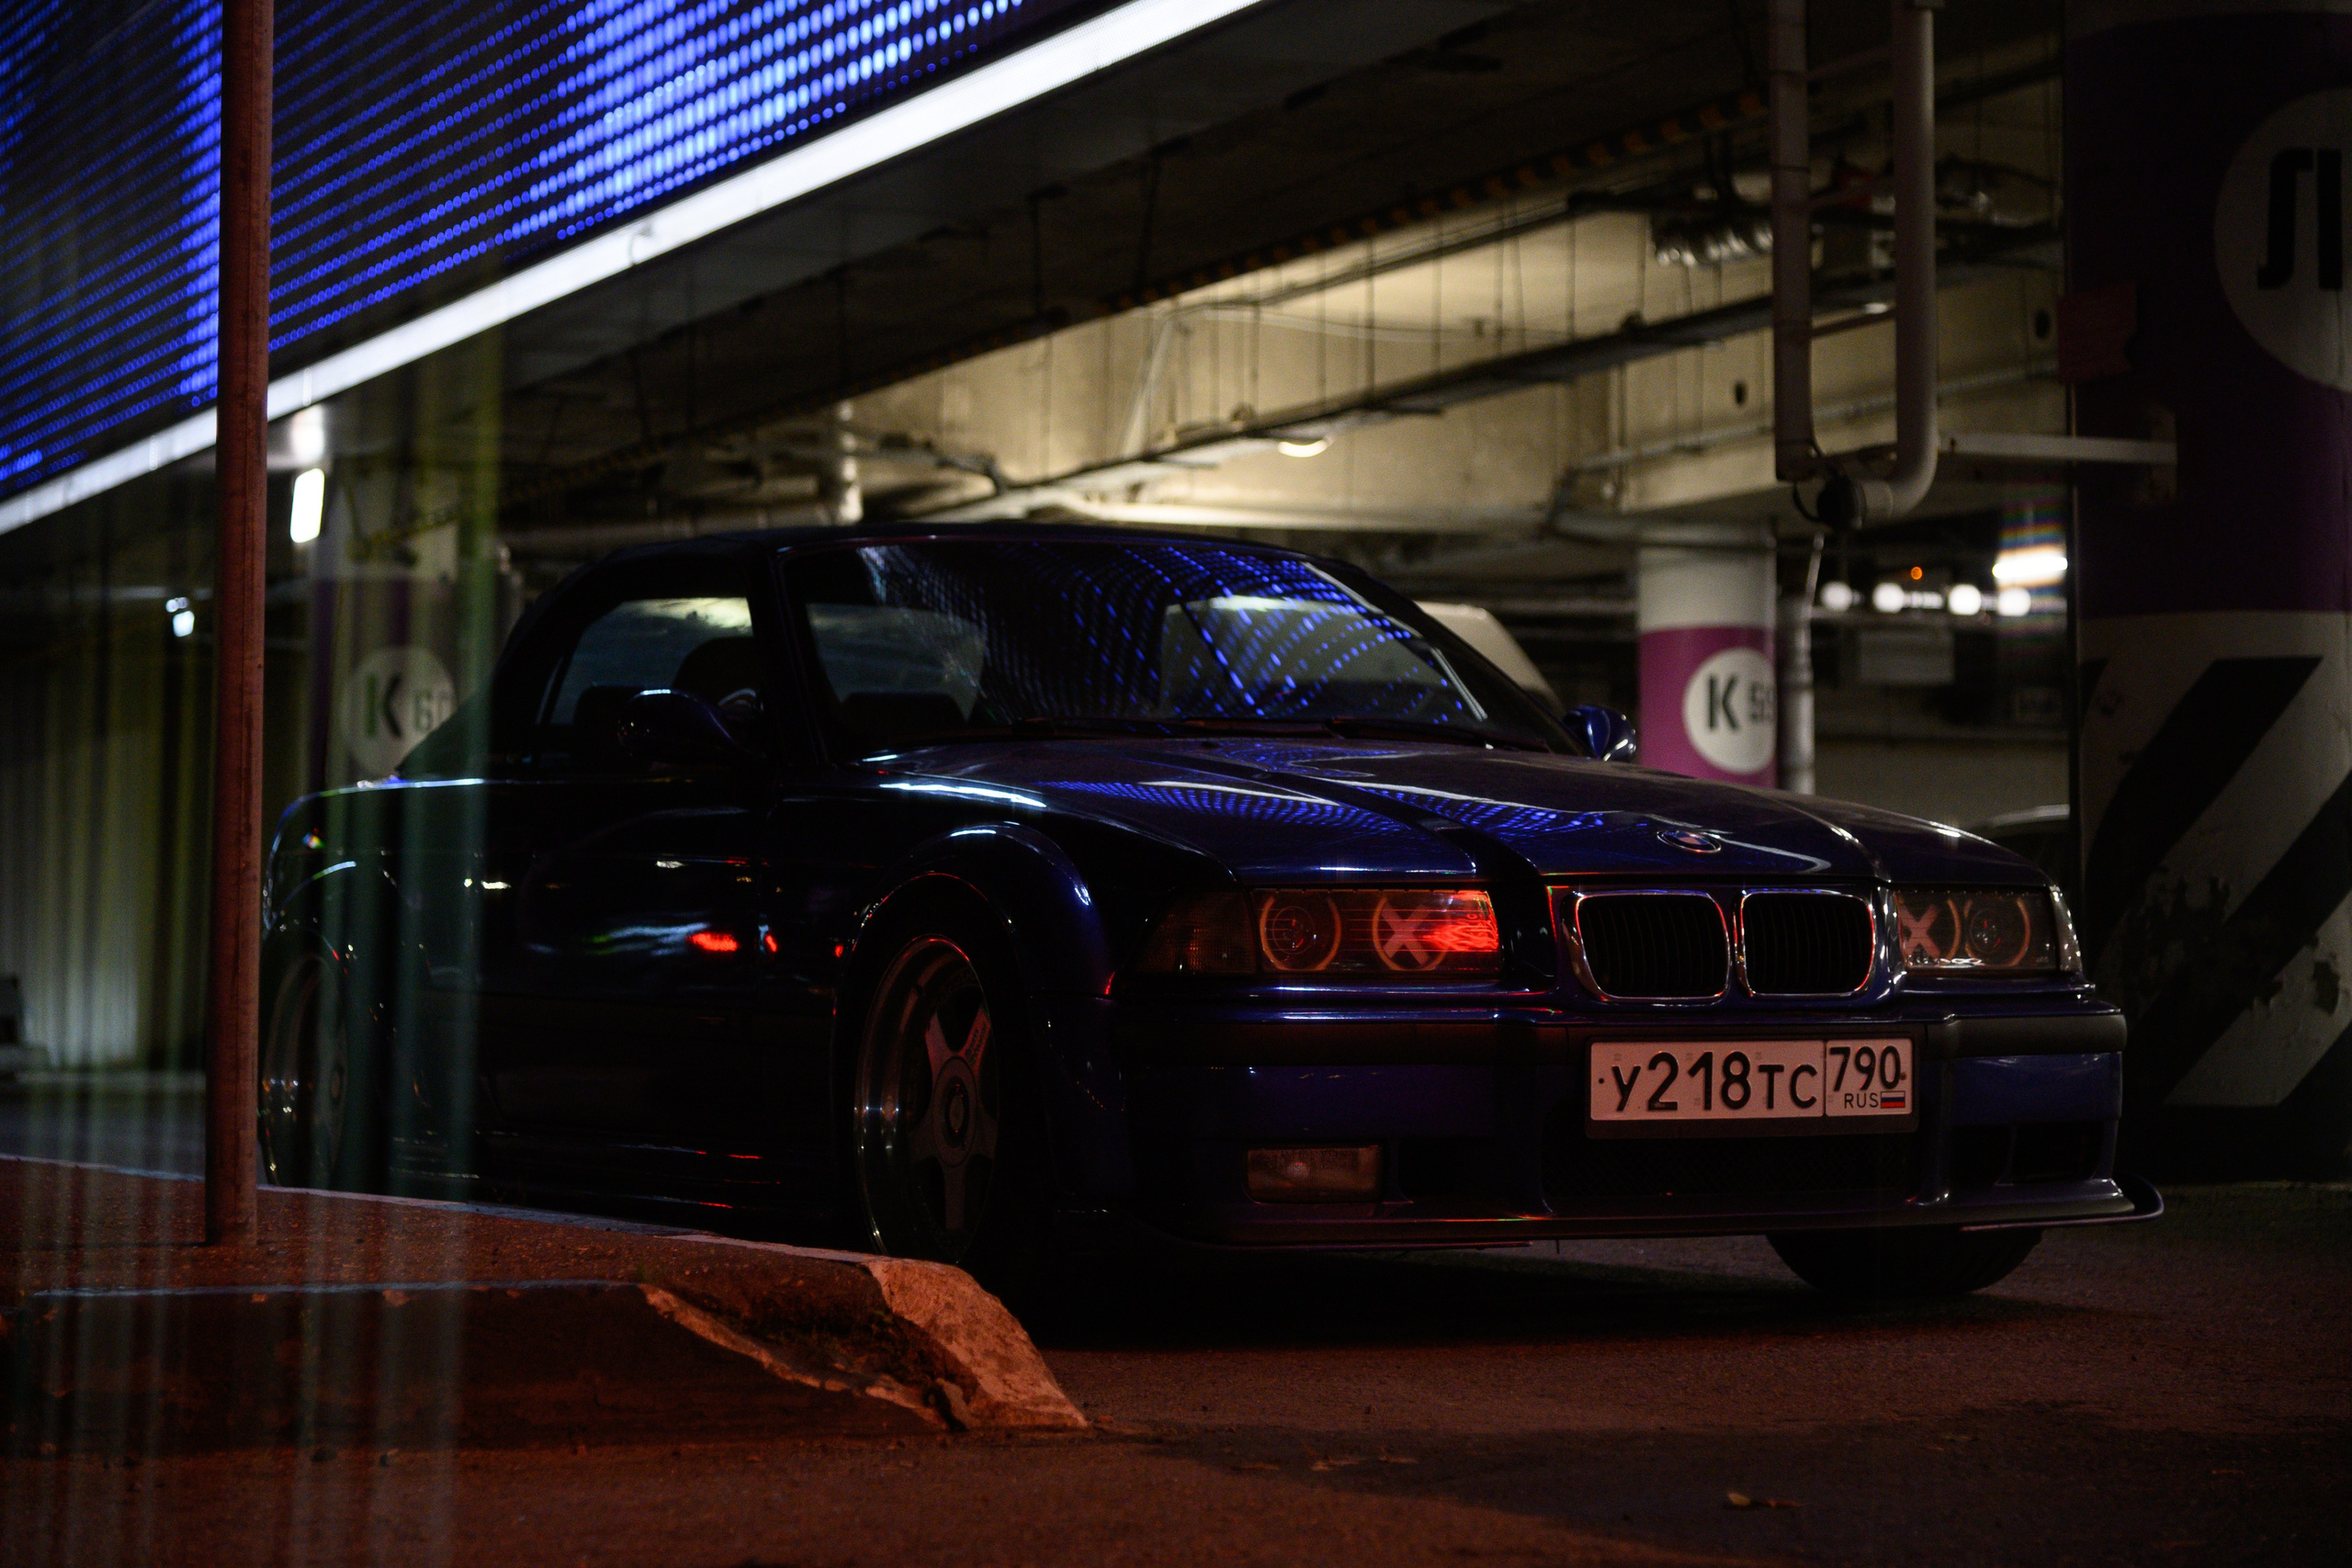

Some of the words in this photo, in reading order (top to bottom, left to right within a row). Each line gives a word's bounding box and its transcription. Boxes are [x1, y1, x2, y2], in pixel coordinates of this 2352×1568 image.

[2257, 149, 2343, 289] Л
[367, 673, 401, 737] К
[1708, 677, 1738, 731] К
[1612, 1051, 1817, 1111] У218ТС
[1829, 1045, 1902, 1091] 790
[1844, 1092, 1880, 1109] RUS
